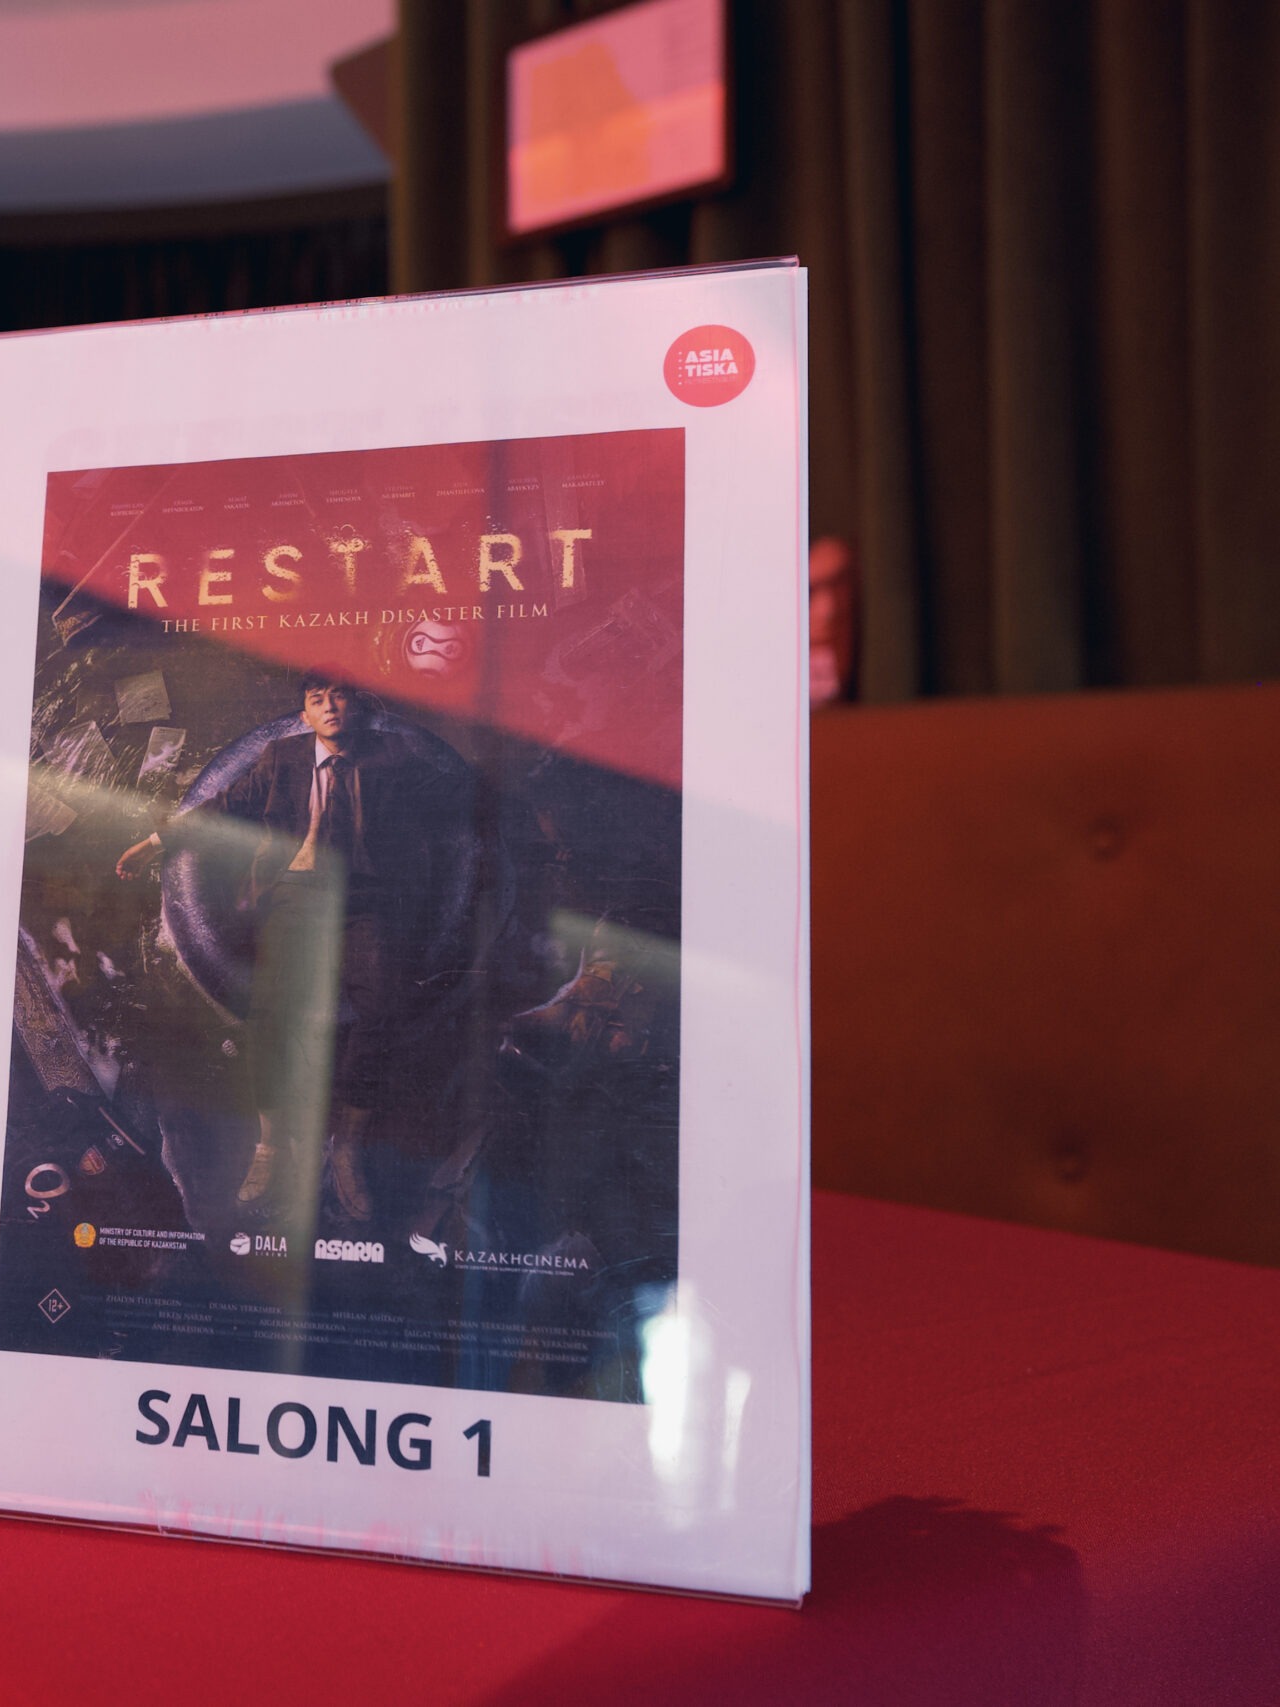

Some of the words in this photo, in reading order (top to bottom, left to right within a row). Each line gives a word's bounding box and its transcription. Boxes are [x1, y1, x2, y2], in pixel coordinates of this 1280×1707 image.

[685, 348, 734, 363] ASIA
[685, 361, 738, 377] TISKA
[127, 527, 593, 609] RESTART
[161, 619, 200, 633] THE
[211, 615, 268, 631] FIRST
[279, 611, 368, 629] KAZAKH
[381, 606, 484, 624] DISASTER
[497, 603, 549, 619] FILM
[99, 1227, 124, 1236] MINISTRY
[124, 1228, 132, 1236] OF
[132, 1229, 156, 1237] CULTURE
[156, 1230, 168, 1238] AND
[168, 1231, 205, 1240] INFORMATION
[99, 1237, 107, 1245] OF
[107, 1238, 116, 1246] THE
[117, 1238, 143, 1247] REPUBLIC
[143, 1240, 151, 1248] OF
[151, 1240, 187, 1249] KAZAKHSTAN
[255, 1235, 287, 1252] DALA
[454, 1250, 589, 1270] KAZAKHCINEMA
[48, 1299, 63, 1312] 12+
[135, 1389, 432, 1471] SALONG
[462, 1418, 492, 1478] 1
